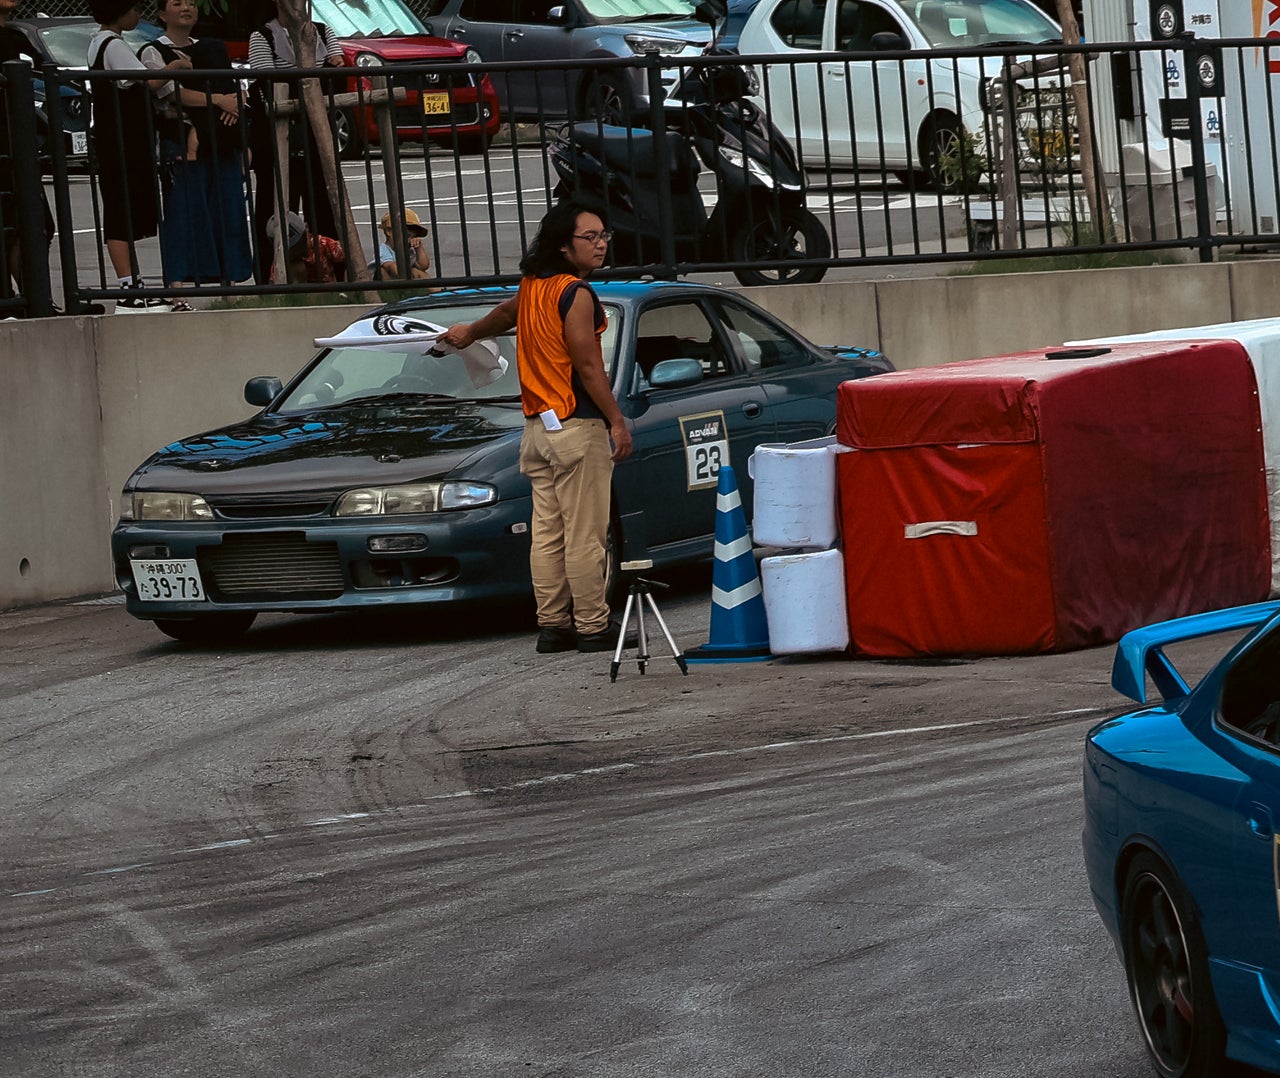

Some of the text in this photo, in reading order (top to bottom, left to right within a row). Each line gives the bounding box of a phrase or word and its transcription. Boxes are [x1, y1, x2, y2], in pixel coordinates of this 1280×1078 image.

[689, 424, 719, 438] ADVAN
[695, 445, 721, 480] 23
[148, 577, 199, 598] 39-73
